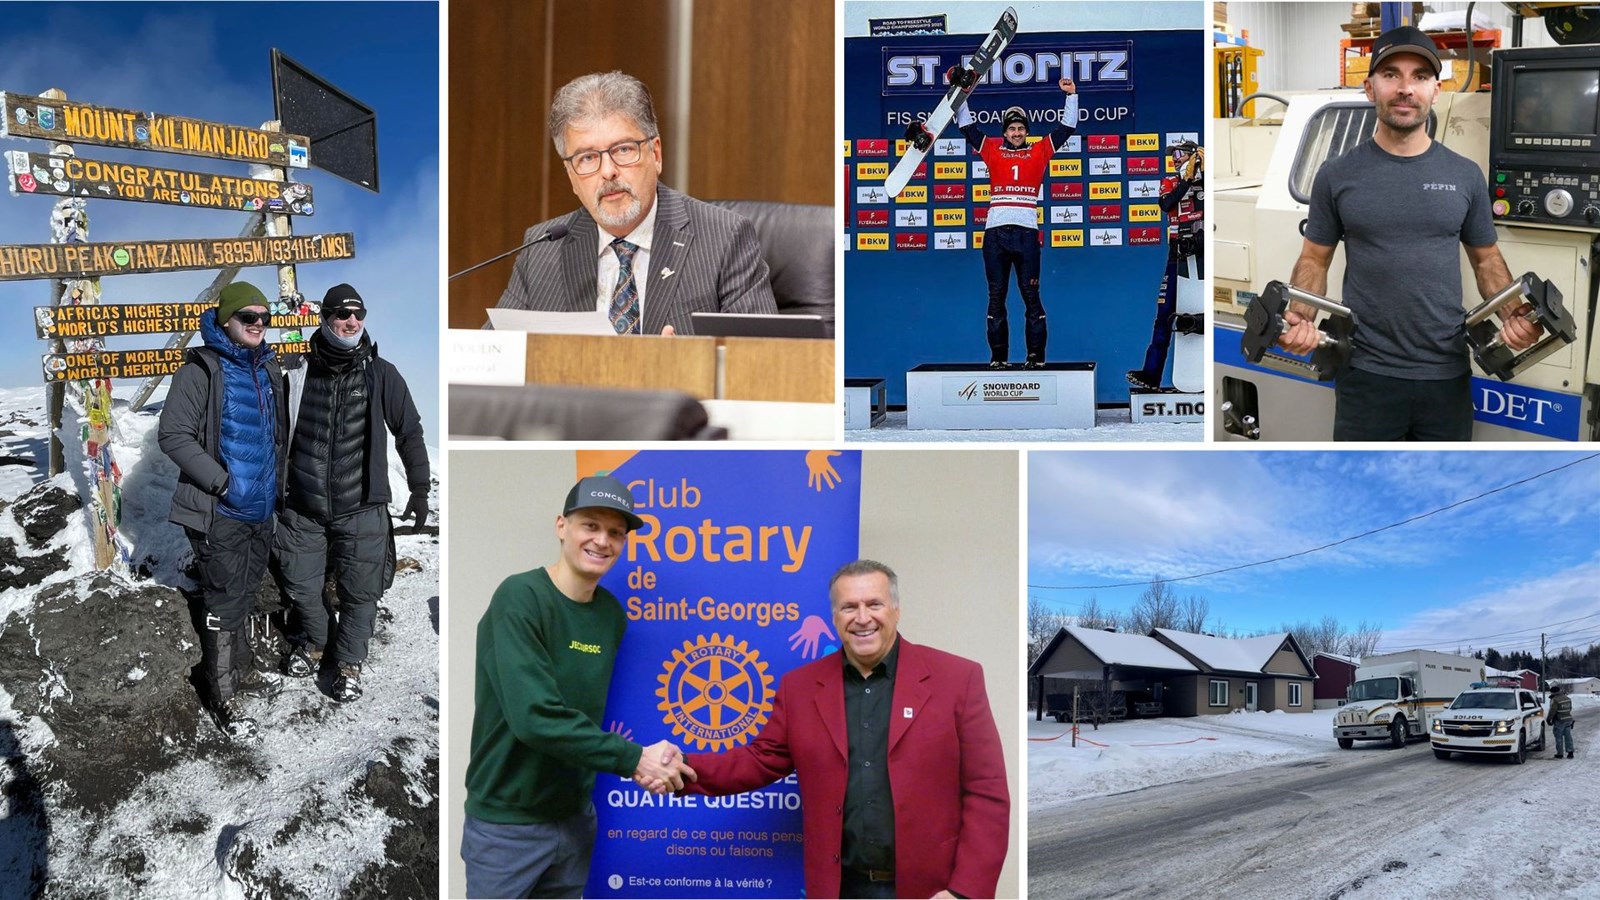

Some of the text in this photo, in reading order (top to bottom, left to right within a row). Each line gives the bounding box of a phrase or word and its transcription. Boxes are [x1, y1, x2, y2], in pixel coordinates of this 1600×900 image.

[887, 111, 911, 125] FIS
[1029, 108, 1089, 123] WORD
[1094, 107, 1129, 121] CUP
[63, 105, 269, 159] MOUNT KILIMANJARO
[65, 159, 280, 199] CONGRATULATIONS
[1011, 165, 1019, 180] 1
[116, 184, 244, 209] YOU ARE NOW AT
[1, 247, 57, 276] HURU
[124, 242, 211, 269] TANZANIA,
[320, 235, 351, 258] AMSL
[57, 306, 120, 321] AFRICA'S
[125, 304, 180, 318] HIGHEST
[58, 314, 319, 336] WORLD'S HIGHEST FRE MOUNTAIN
[66, 354, 96, 367] ONE
[102, 352, 119, 365] OF
[126, 350, 182, 363] WORLD'S
[123, 362, 186, 376] HERITAG
[1142, 402, 1172, 416] ST.
[627, 513, 812, 573] Rotary
[627, 566, 657, 589] de
[626, 596, 800, 627] Saint-Georges
[690, 646, 741, 661] ROTARY
[675, 710, 758, 739] INTERNATIONAL
[607, 789, 801, 810] QUATRE QUESTIO
[607, 830, 623, 838] en
[626, 828, 668, 842] regard
[671, 828, 687, 839] de
[691, 830, 707, 839] ce
[711, 830, 734, 843] que
[737, 831, 768, 840] nous
[666, 844, 774, 857] disons ou faisons
[629, 877, 661, 886] Est-ce
[664, 877, 712, 887] conforme
[714, 877, 721, 887] à
[724, 877, 734, 887] la
[736, 877, 765, 888] vérité
